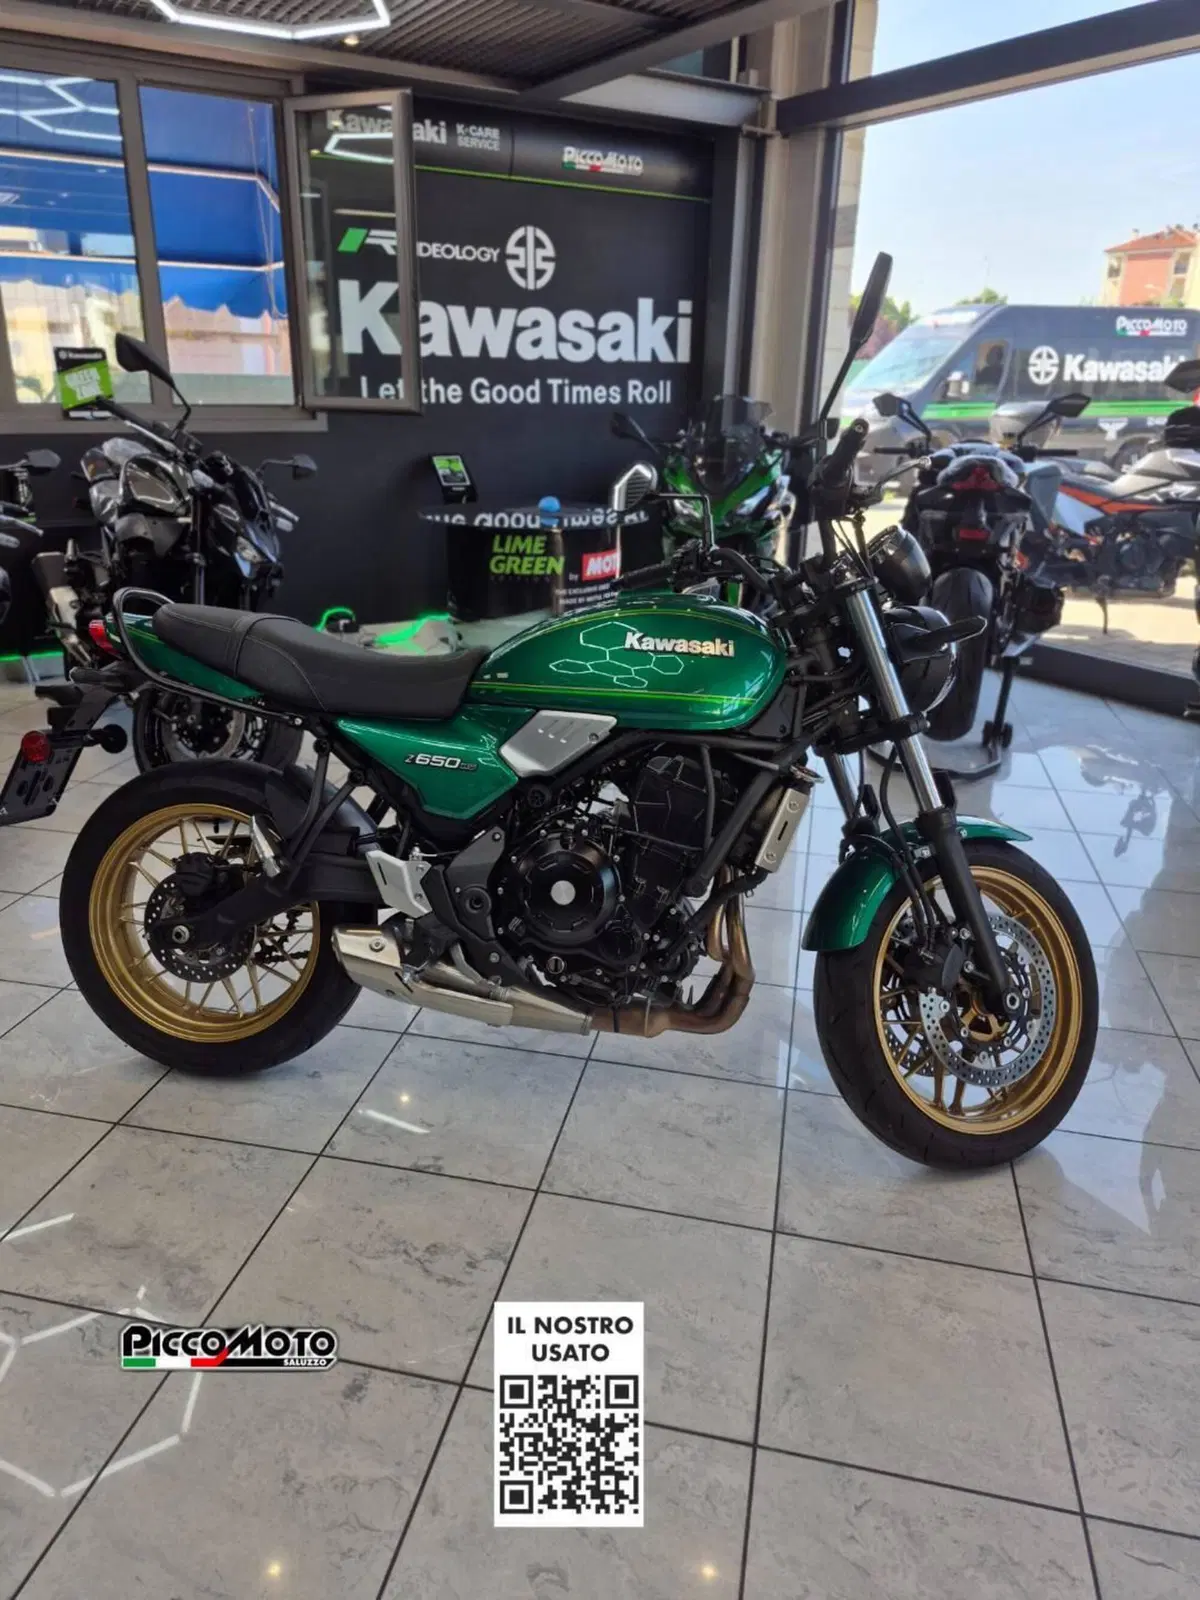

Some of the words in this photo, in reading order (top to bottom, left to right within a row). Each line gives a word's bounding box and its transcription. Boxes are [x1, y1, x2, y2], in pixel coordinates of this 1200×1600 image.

[326, 109, 447, 145] Kawaaki
[457, 136, 500, 150] SERVICE
[338, 278, 693, 364] Kawasaki
[421, 377, 463, 405] the
[470, 376, 541, 405] Good
[546, 378, 622, 405] Times
[627, 379, 672, 405] Roll
[492, 535, 547, 554] LIME
[489, 555, 565, 576] GREEN
[624, 631, 735, 657] Kawasaki
